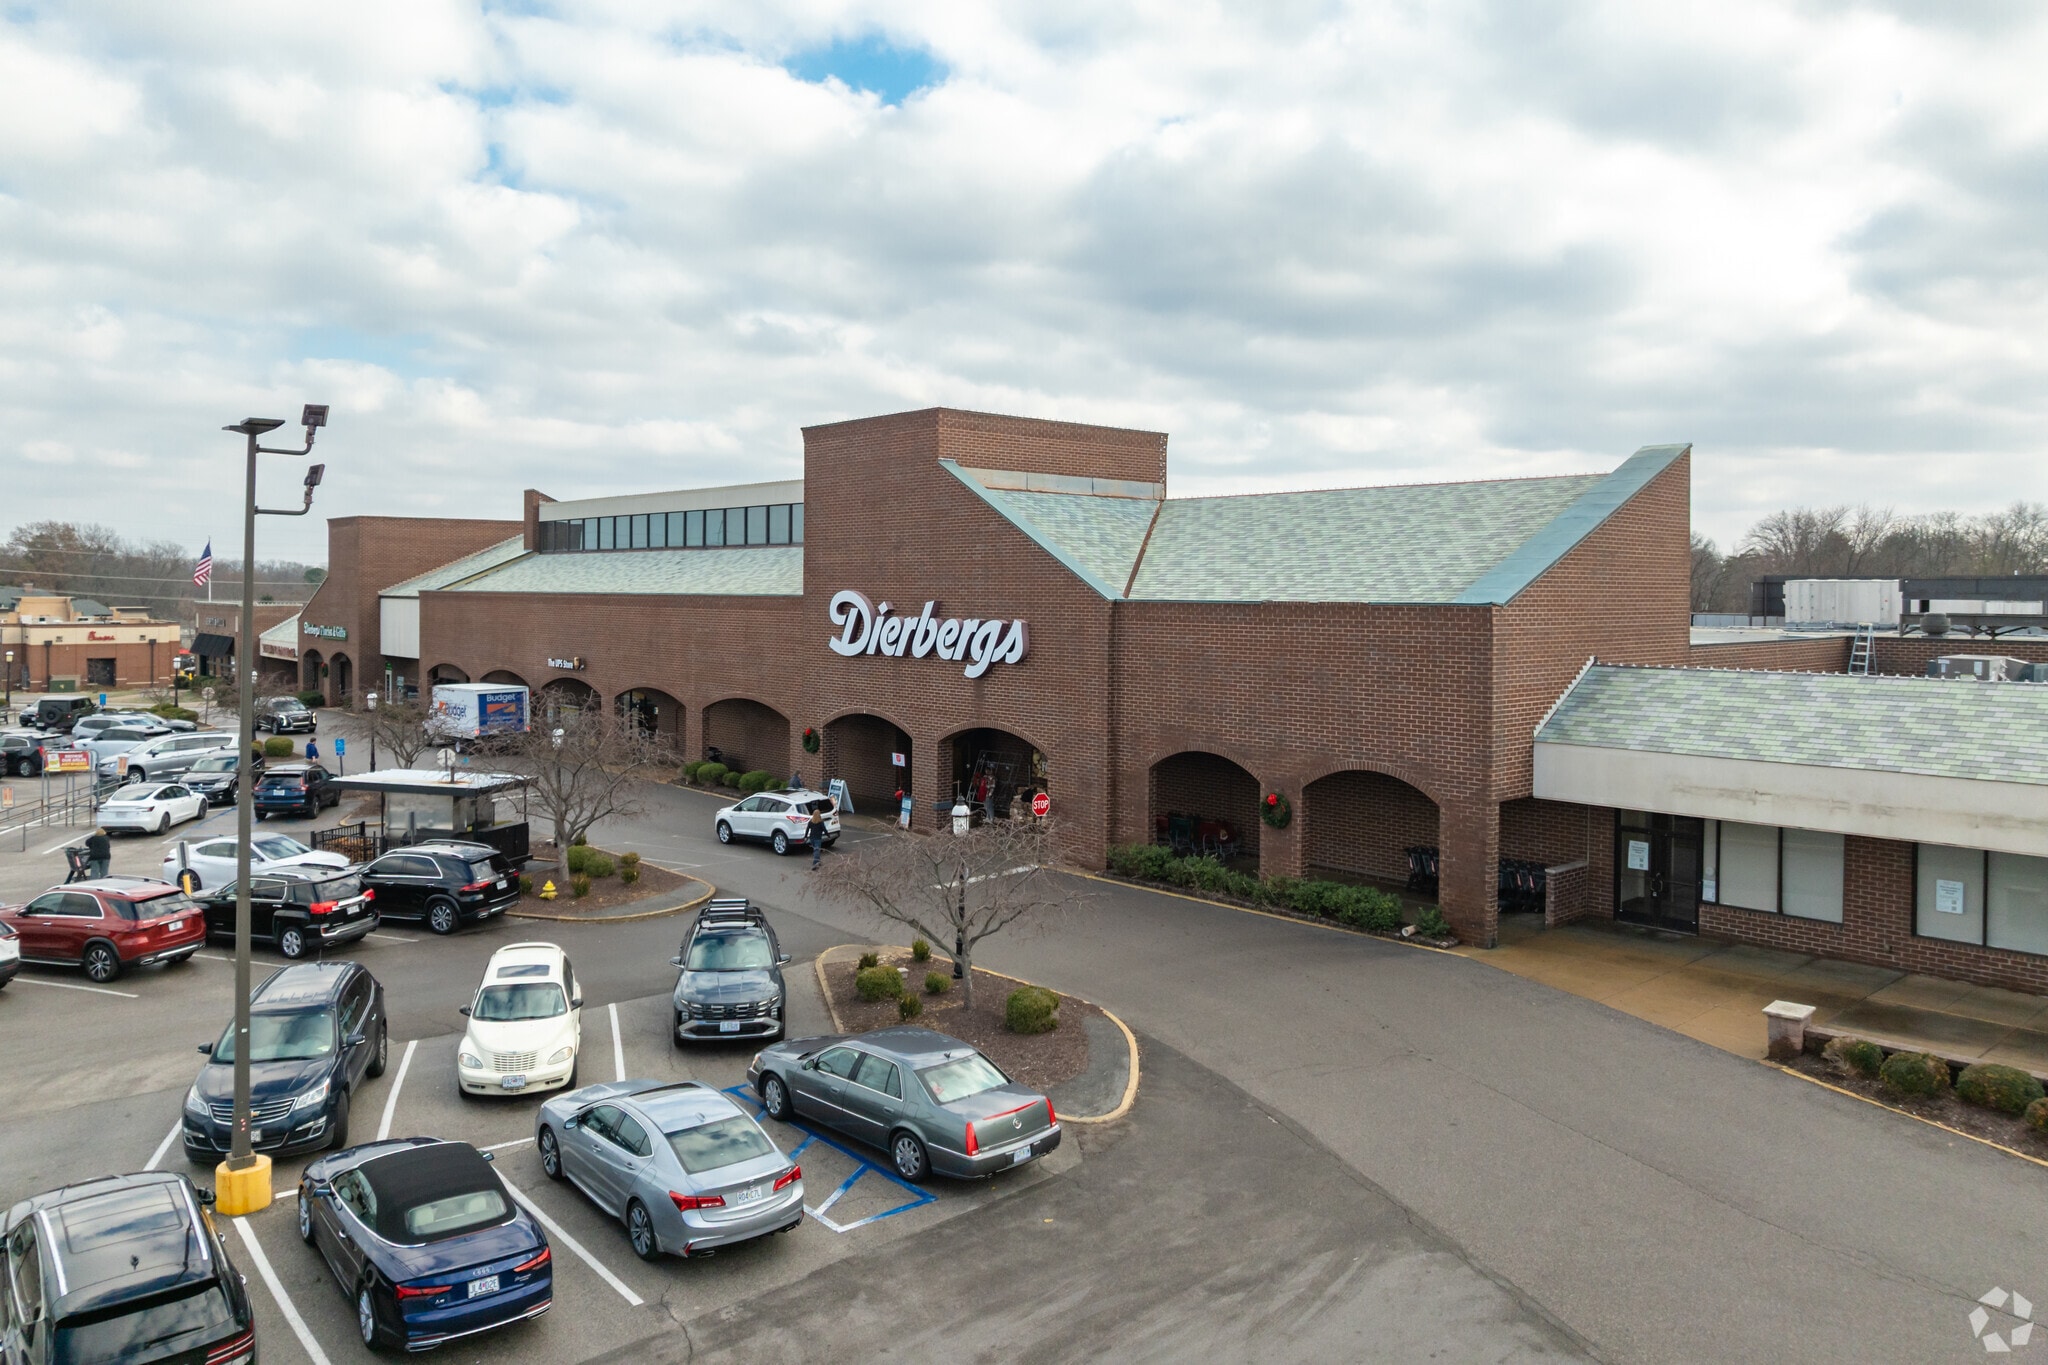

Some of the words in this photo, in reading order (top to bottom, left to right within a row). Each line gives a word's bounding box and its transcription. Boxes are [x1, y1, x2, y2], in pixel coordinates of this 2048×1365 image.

[829, 590, 1026, 679] Dierbergs
[555, 659, 563, 668] UPS
[563, 660, 573, 669] Store
[486, 694, 516, 703] Budget
[446, 702, 467, 720] Budget
[1034, 800, 1049, 810] STOP
